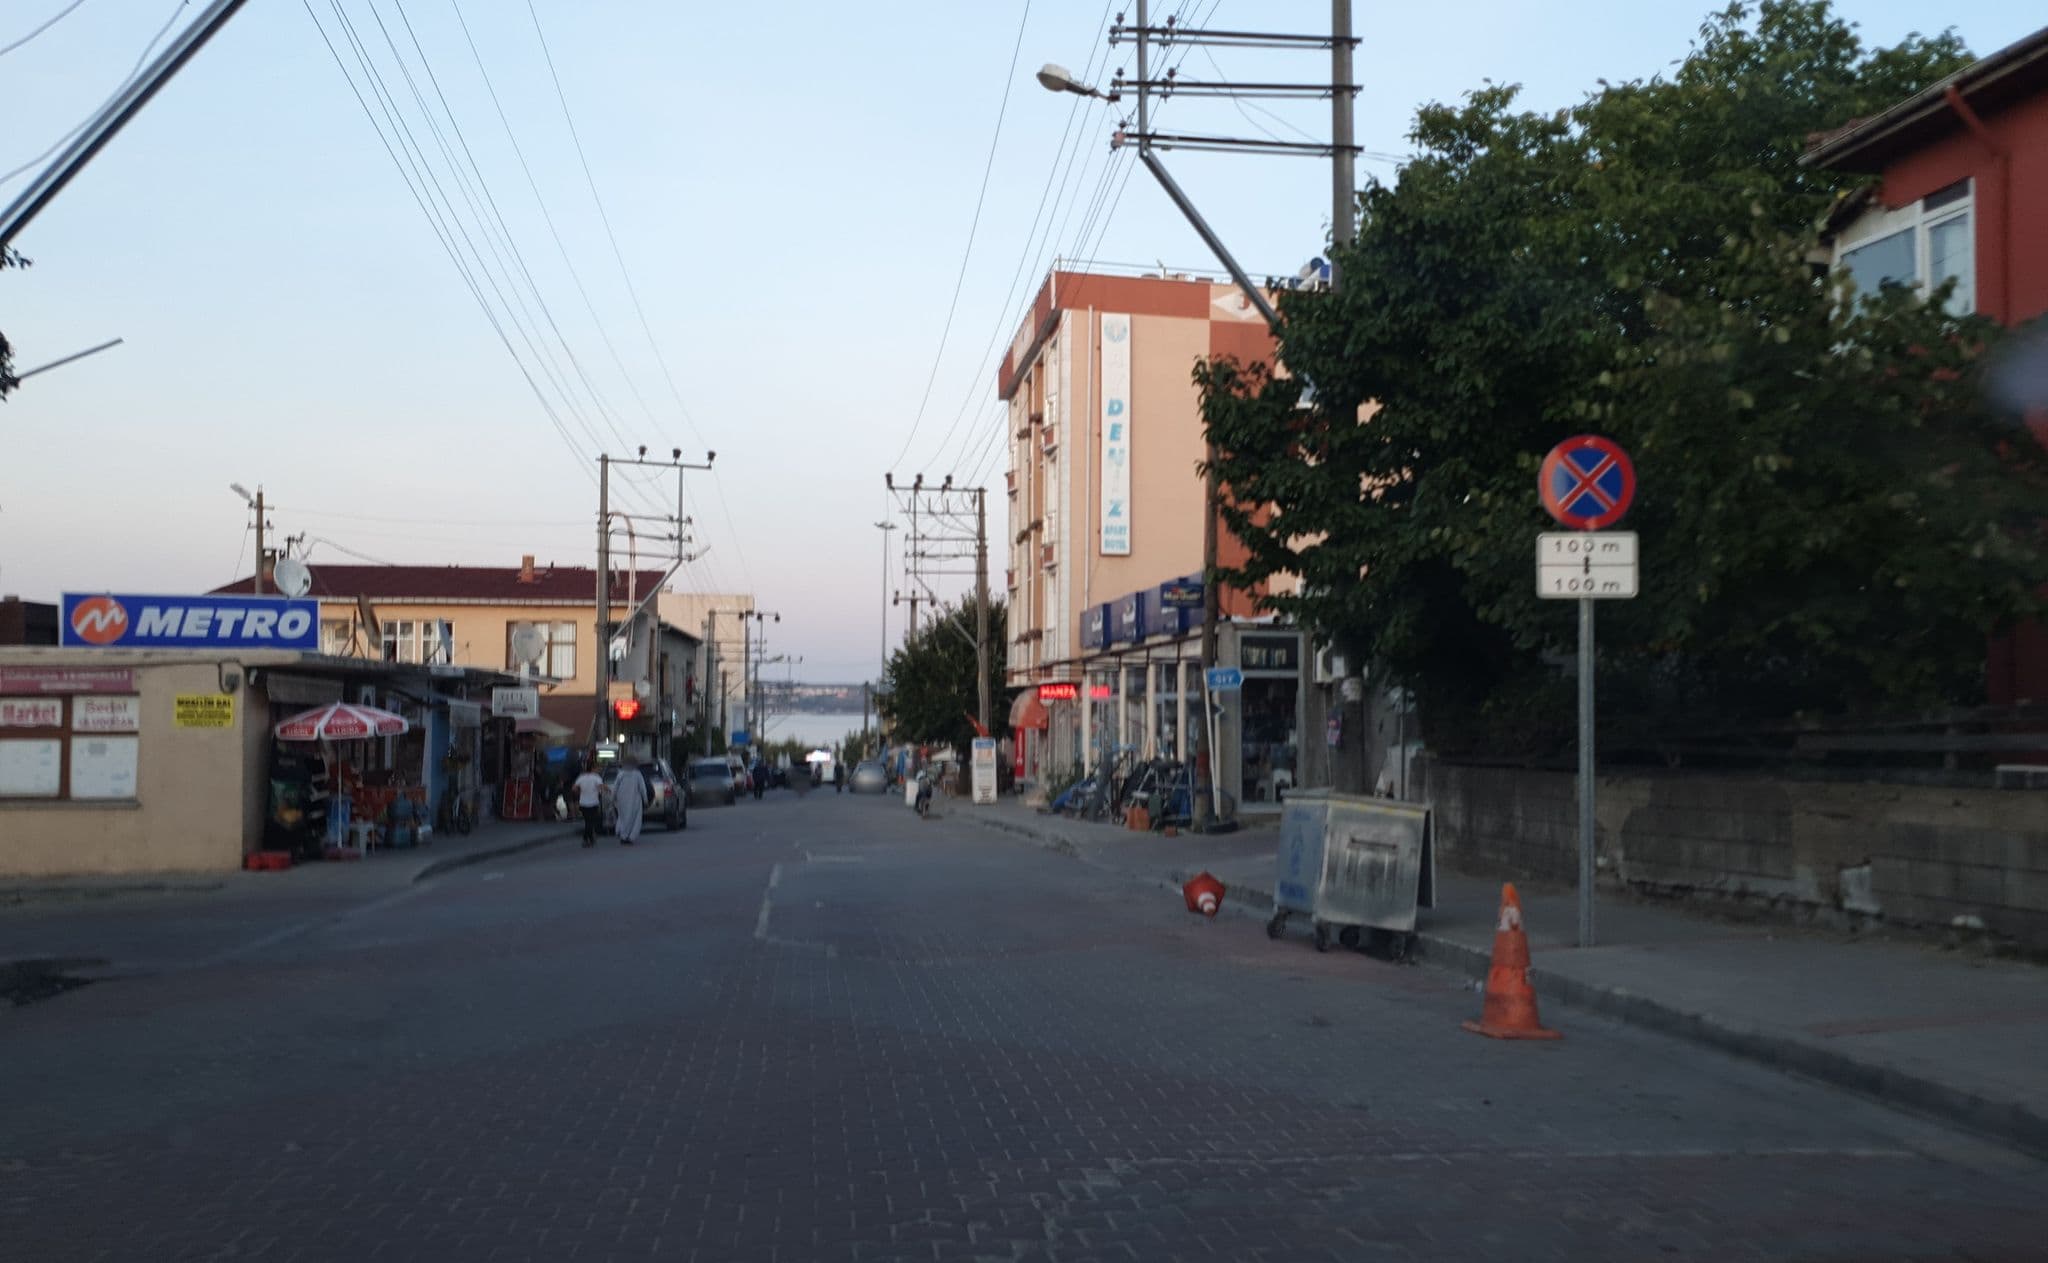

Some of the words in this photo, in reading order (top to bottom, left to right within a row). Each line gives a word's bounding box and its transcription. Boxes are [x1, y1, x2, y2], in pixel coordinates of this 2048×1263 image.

[1554, 539, 1595, 553] 100
[1601, 541, 1620, 553] m
[1554, 578, 1595, 592] 100
[1601, 580, 1620, 592] m
[134, 606, 312, 640] METRO
